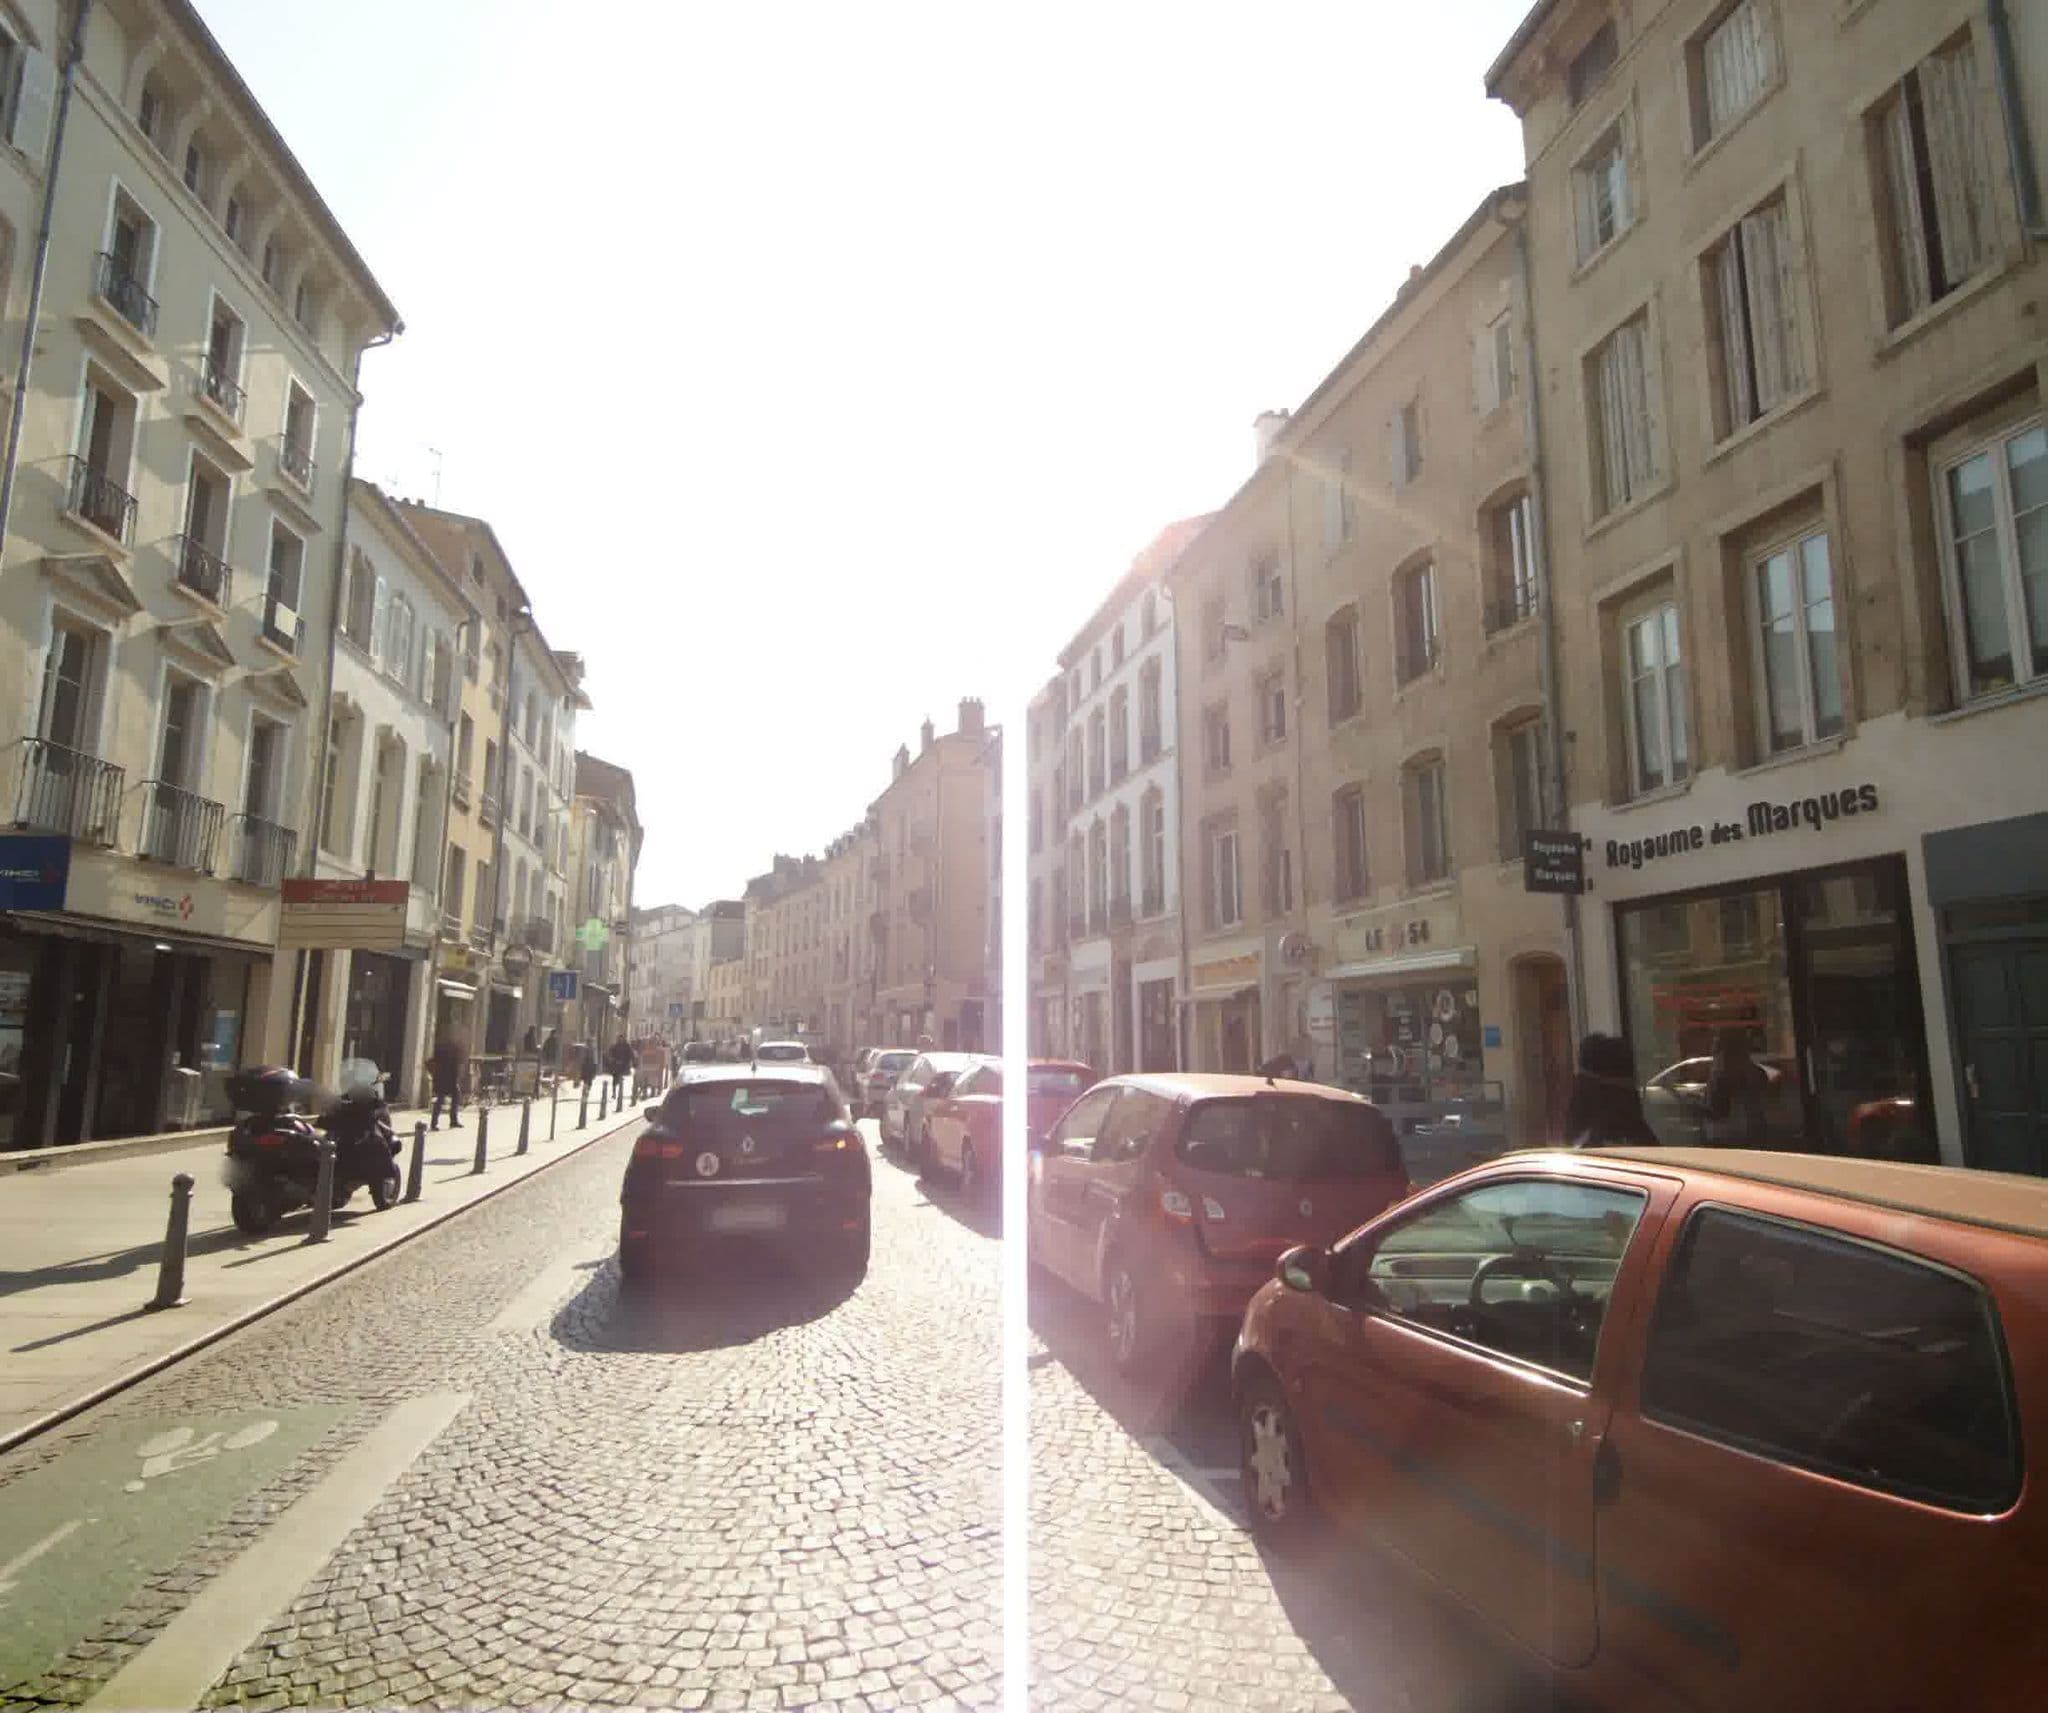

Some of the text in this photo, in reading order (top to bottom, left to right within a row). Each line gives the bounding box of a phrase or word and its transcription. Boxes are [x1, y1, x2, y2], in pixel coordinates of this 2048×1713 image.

[1605, 784, 1876, 868] Royaume des Marques
